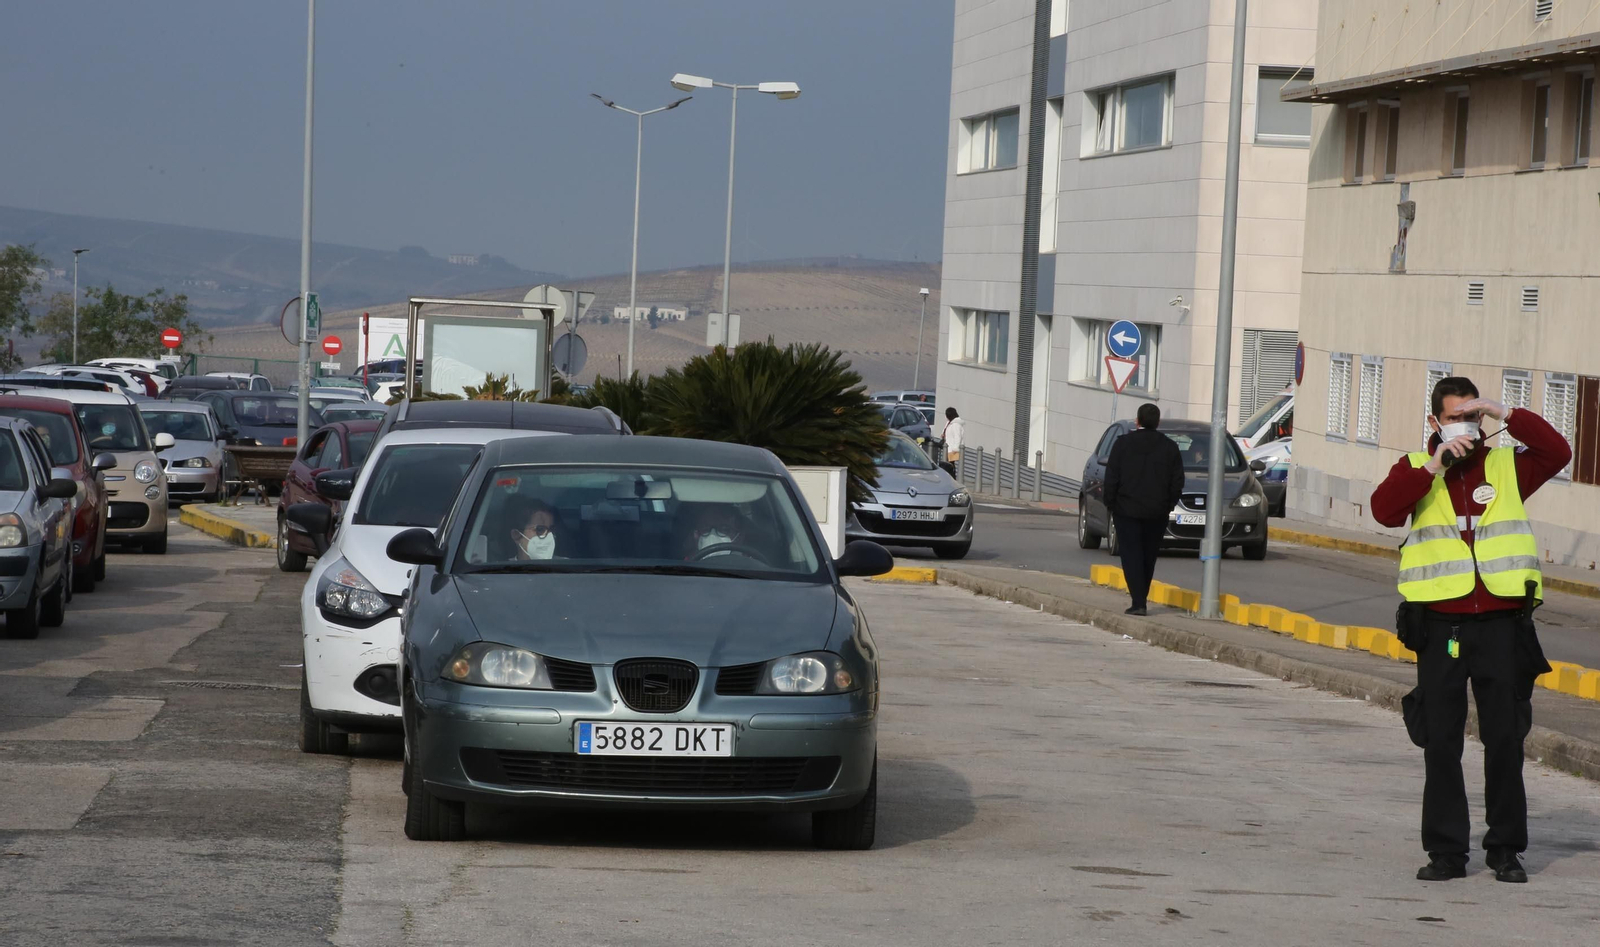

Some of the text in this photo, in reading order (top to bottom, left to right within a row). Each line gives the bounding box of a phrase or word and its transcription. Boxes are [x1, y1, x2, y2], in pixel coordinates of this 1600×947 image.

[896, 510, 935, 520] 2973 HHJ
[1183, 515, 1203, 523] 4278
[595, 726, 726, 752] 5882 DKT
[581, 740, 588, 748] E
